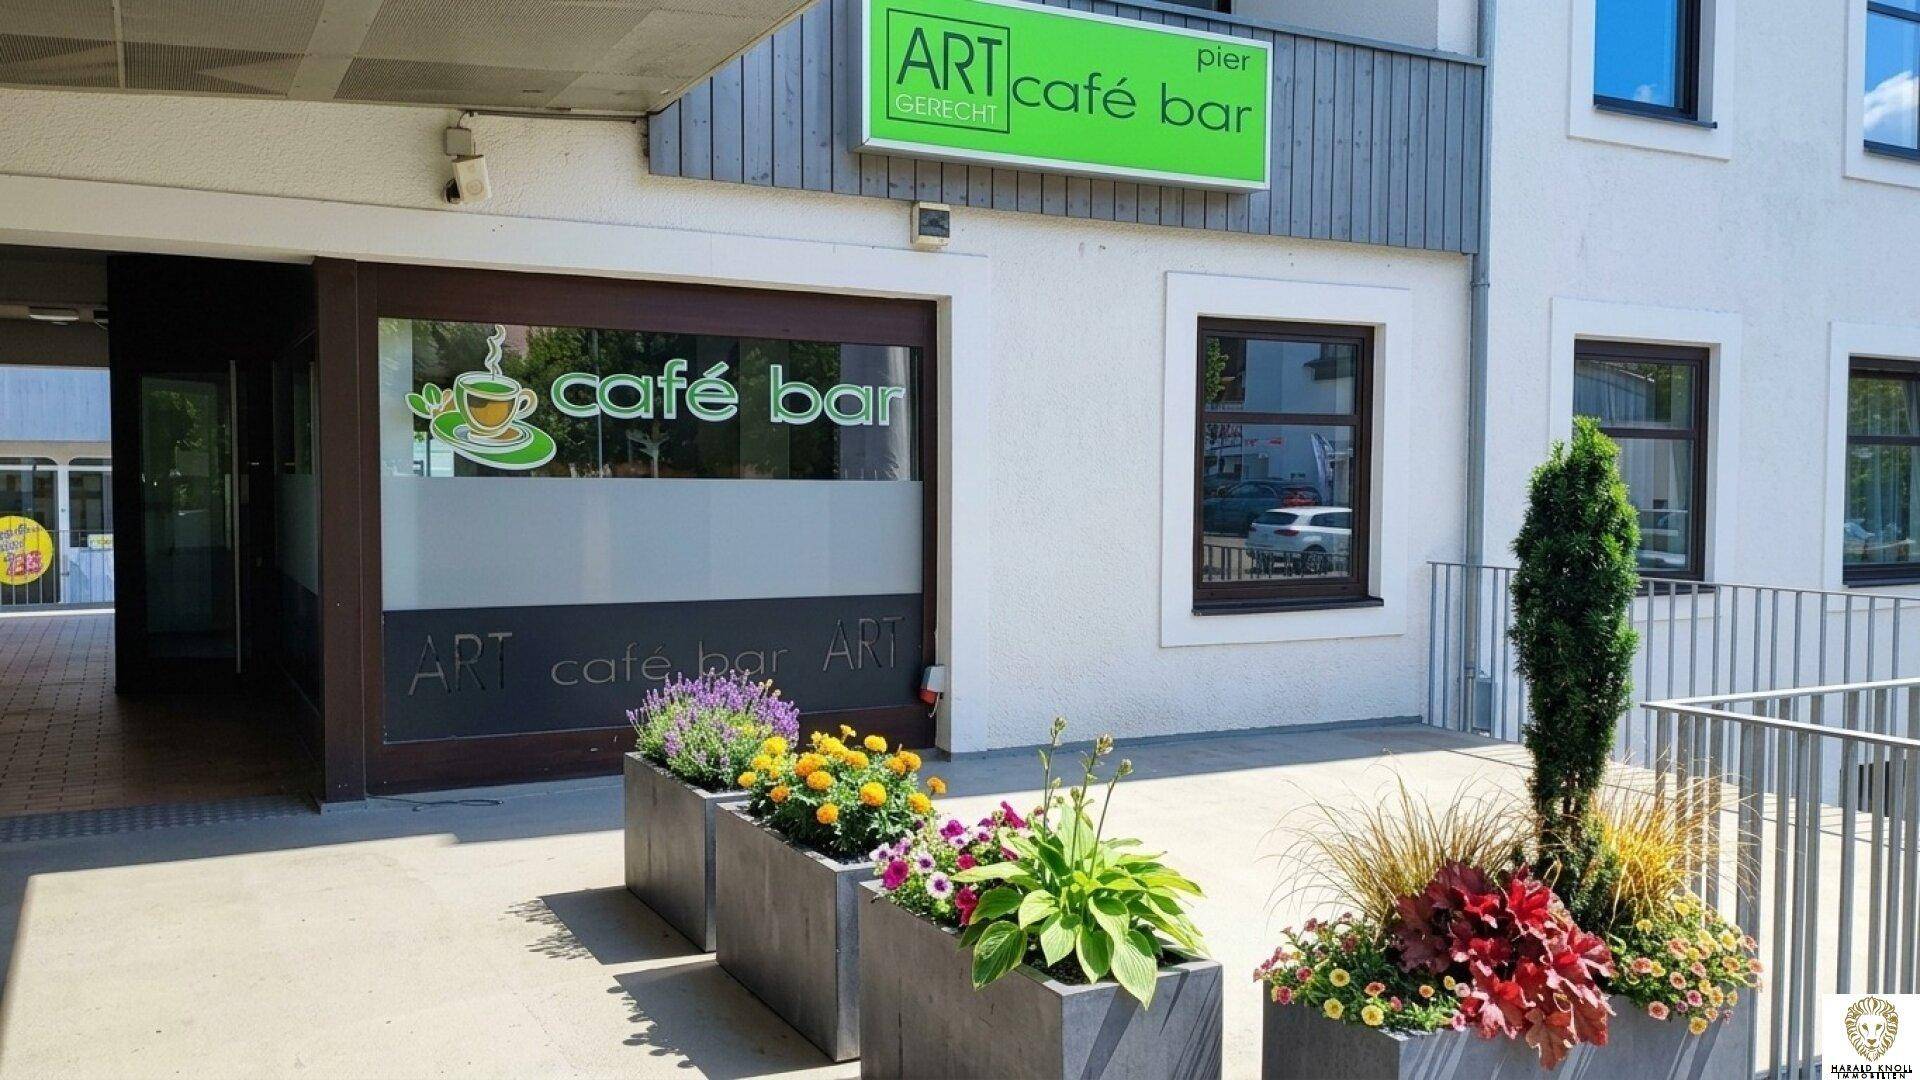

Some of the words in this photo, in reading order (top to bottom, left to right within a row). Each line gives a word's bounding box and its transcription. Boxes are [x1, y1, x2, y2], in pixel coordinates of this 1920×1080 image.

[896, 27, 1003, 97] ART
[1197, 45, 1251, 73] pier
[895, 93, 998, 125] GERECHT
[1012, 72, 1136, 119] café
[1160, 82, 1252, 133] bar
[551, 359, 738, 423] café
[770, 364, 906, 426] bar
[408, 632, 513, 696] ART
[550, 641, 672, 686] café
[698, 640, 788, 677] bar
[822, 616, 905, 671] ART
